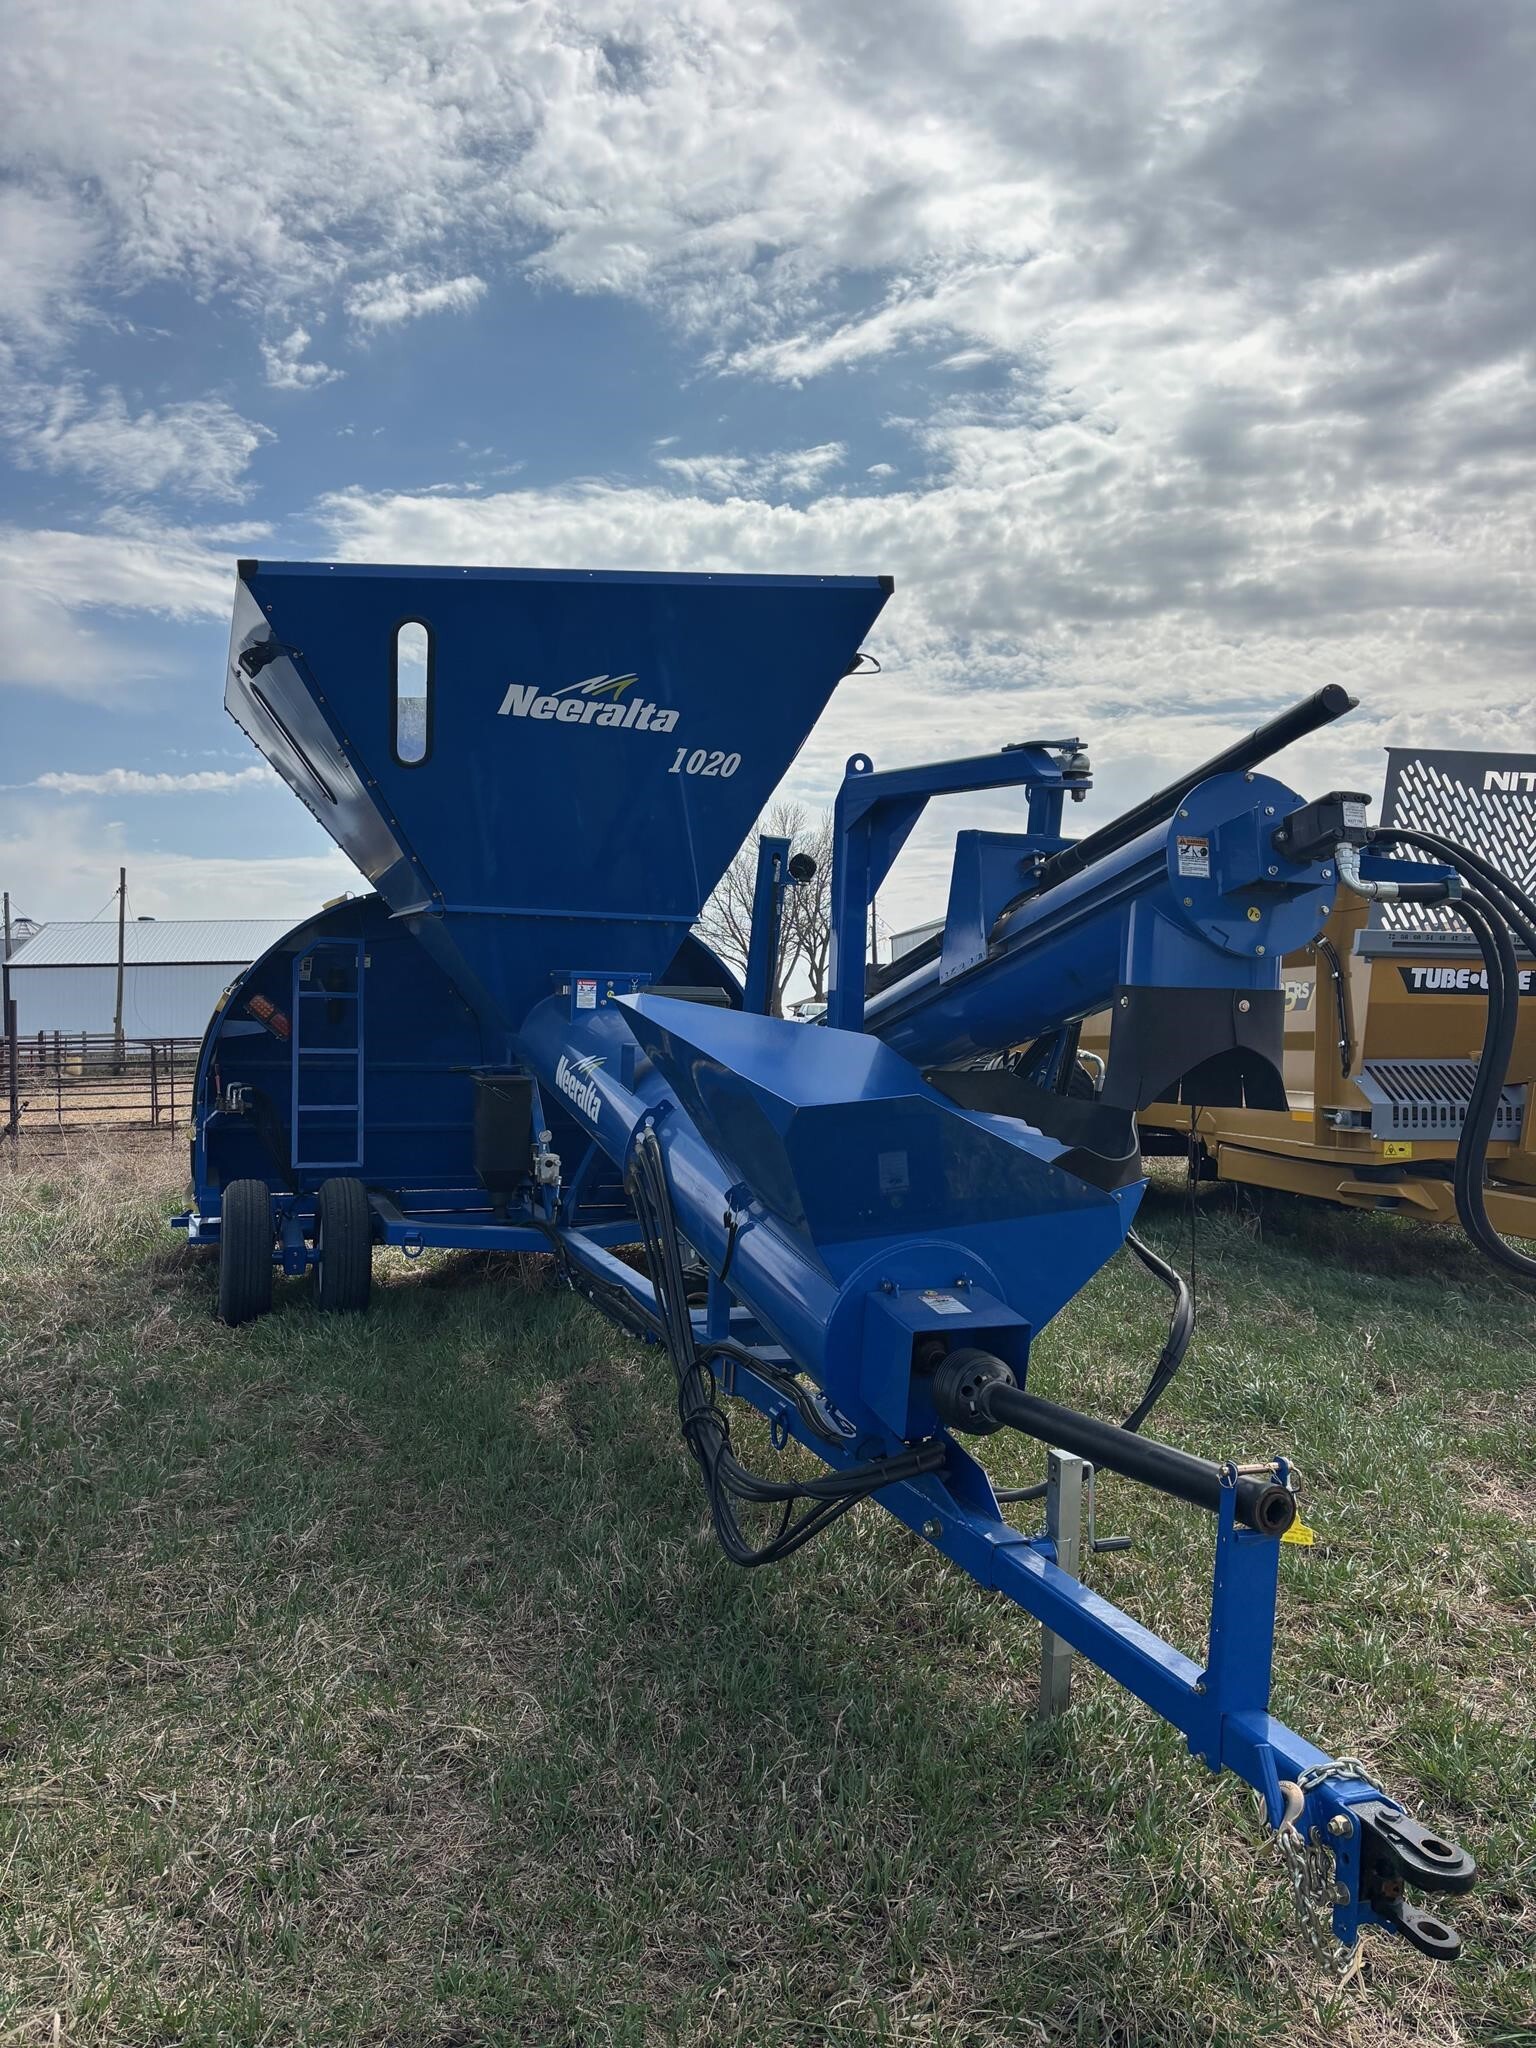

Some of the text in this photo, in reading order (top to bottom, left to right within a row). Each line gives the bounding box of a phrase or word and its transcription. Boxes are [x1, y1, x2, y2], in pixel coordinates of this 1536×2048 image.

[497, 683, 680, 733] Neeralta
[668, 747, 742, 778] 1020
[555, 1054, 602, 1124] Neeralta
